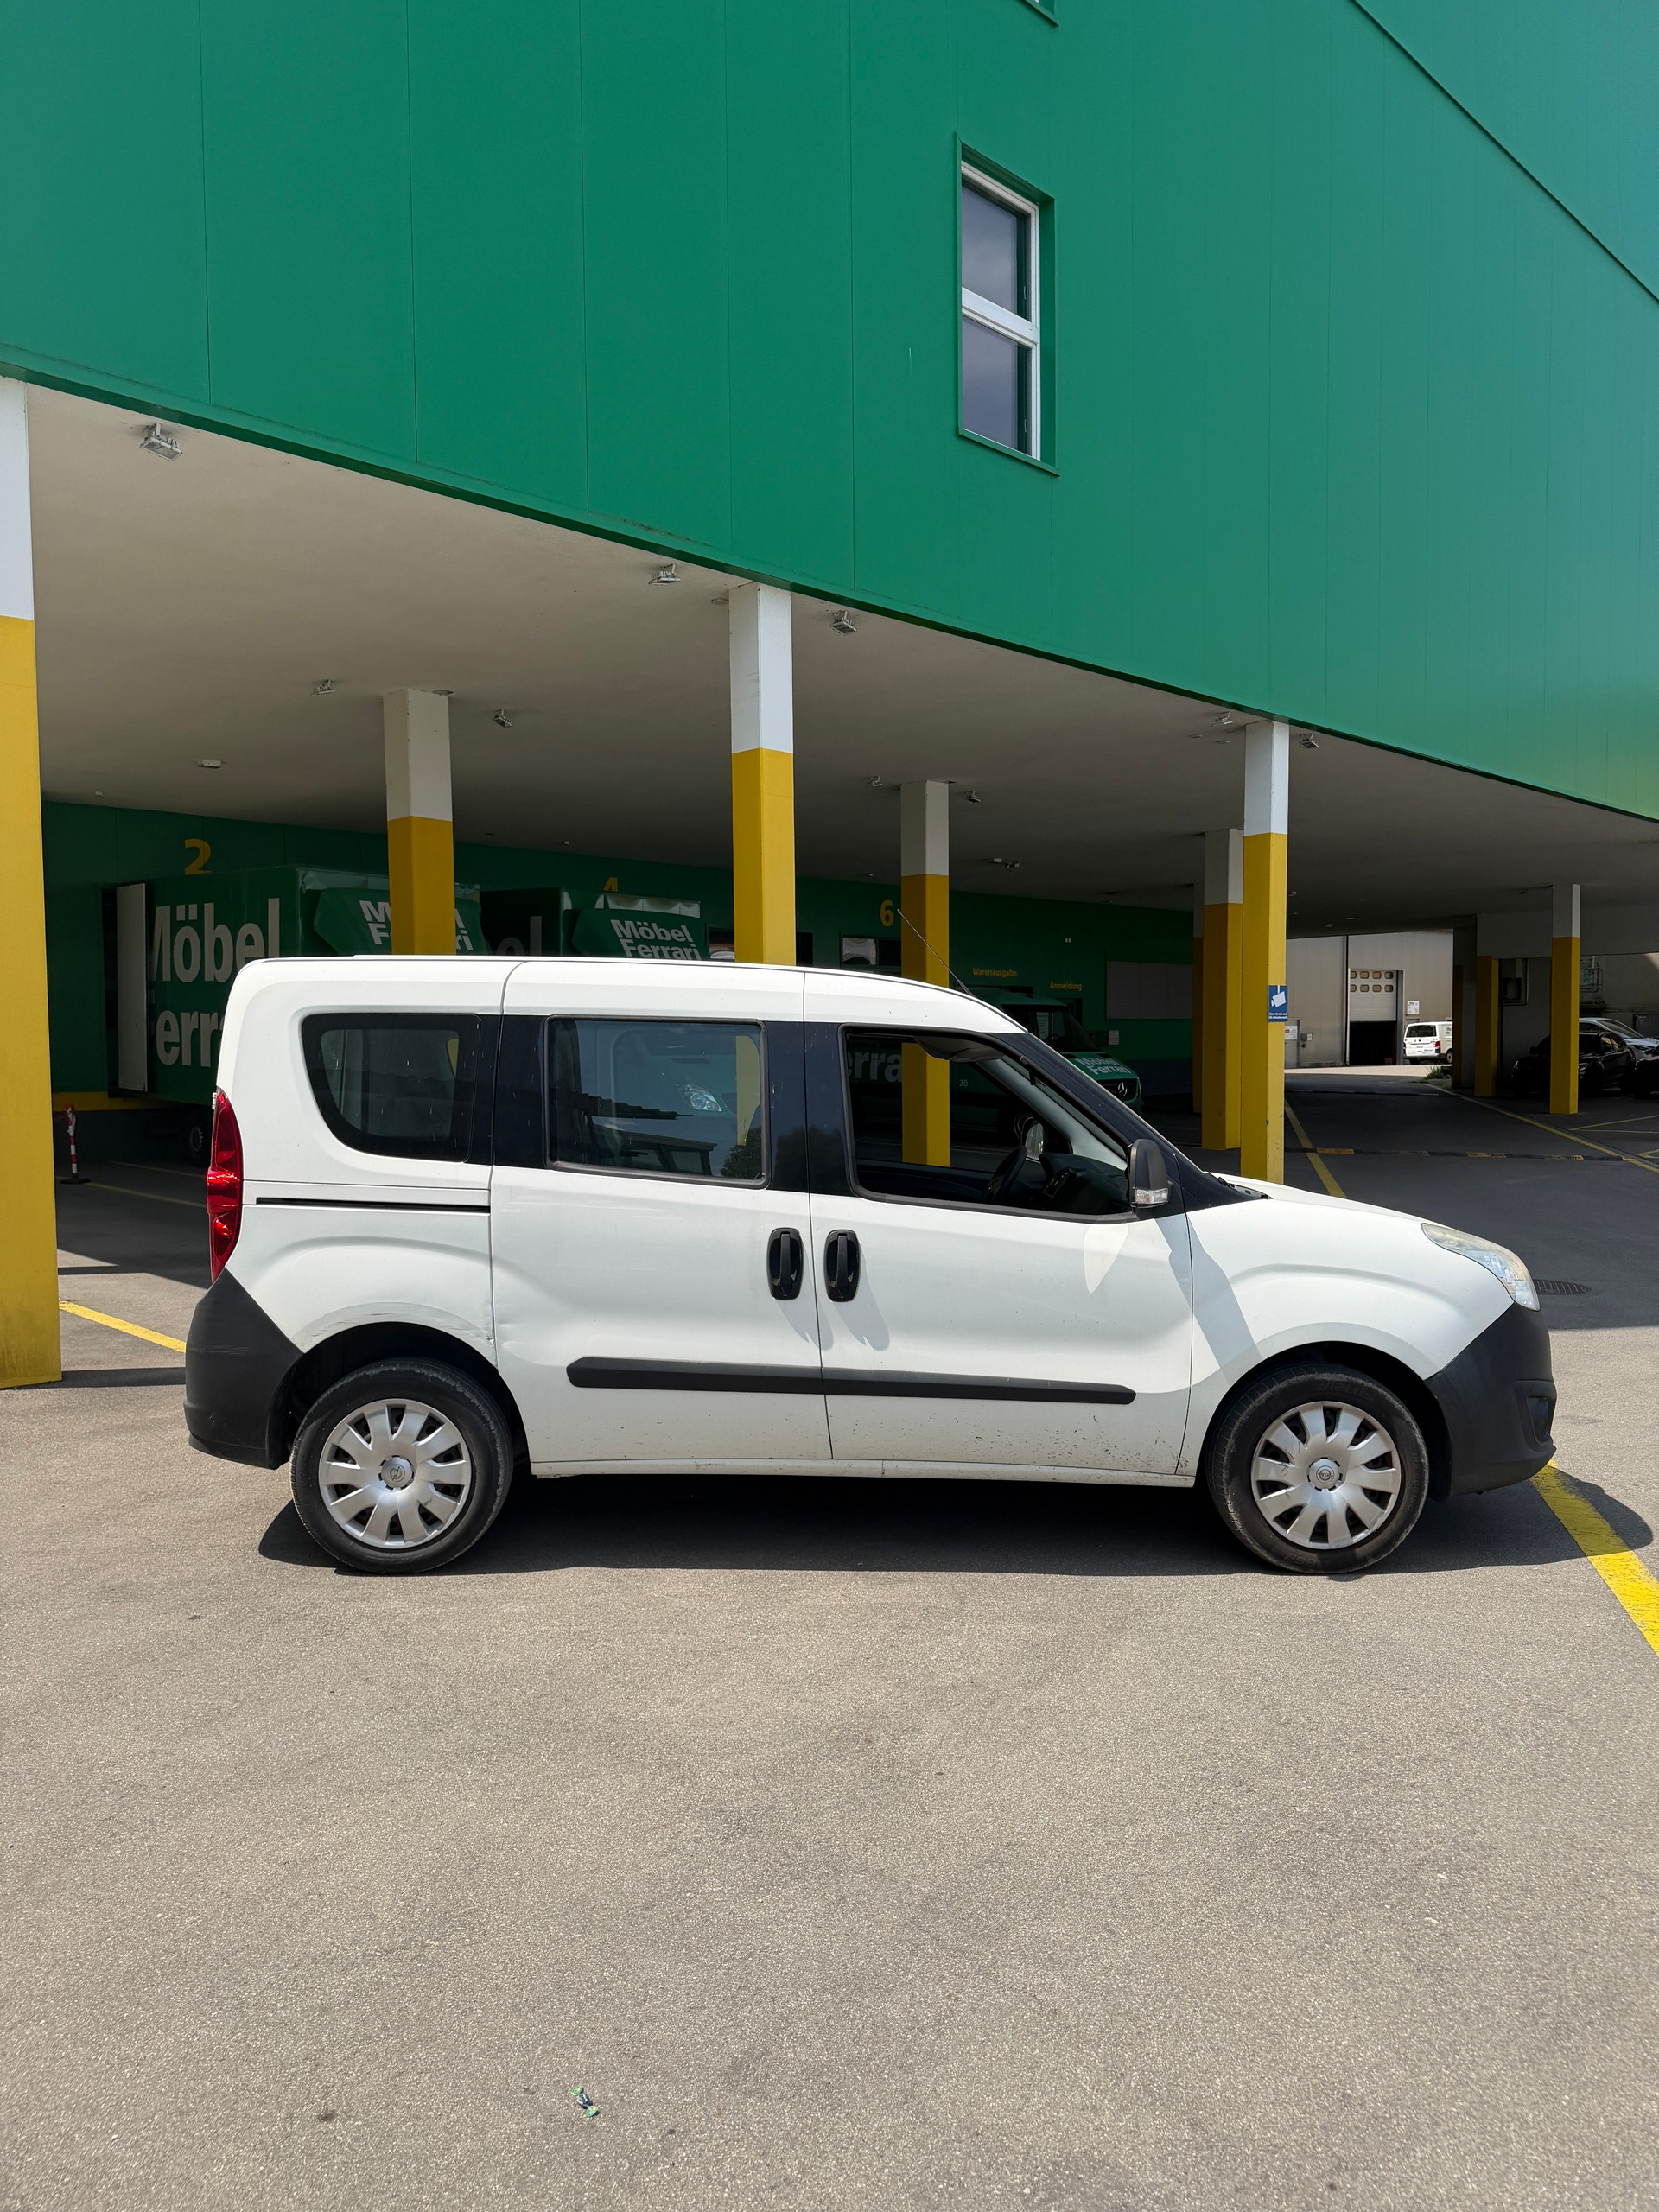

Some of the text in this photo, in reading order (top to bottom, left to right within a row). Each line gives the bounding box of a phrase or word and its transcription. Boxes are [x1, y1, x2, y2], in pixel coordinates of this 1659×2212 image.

[184, 838, 212, 874] 2
[880, 899, 894, 927] 6
[610, 919, 694, 943] Möbel
[620, 939, 702, 960] Ferrari
[972, 968, 1018, 978] Warenausgabe
[1049, 982, 1082, 992] Anmeldung
[1087, 1065, 1132, 1075] Ferrari
[957, 1079, 969, 1088] 30
